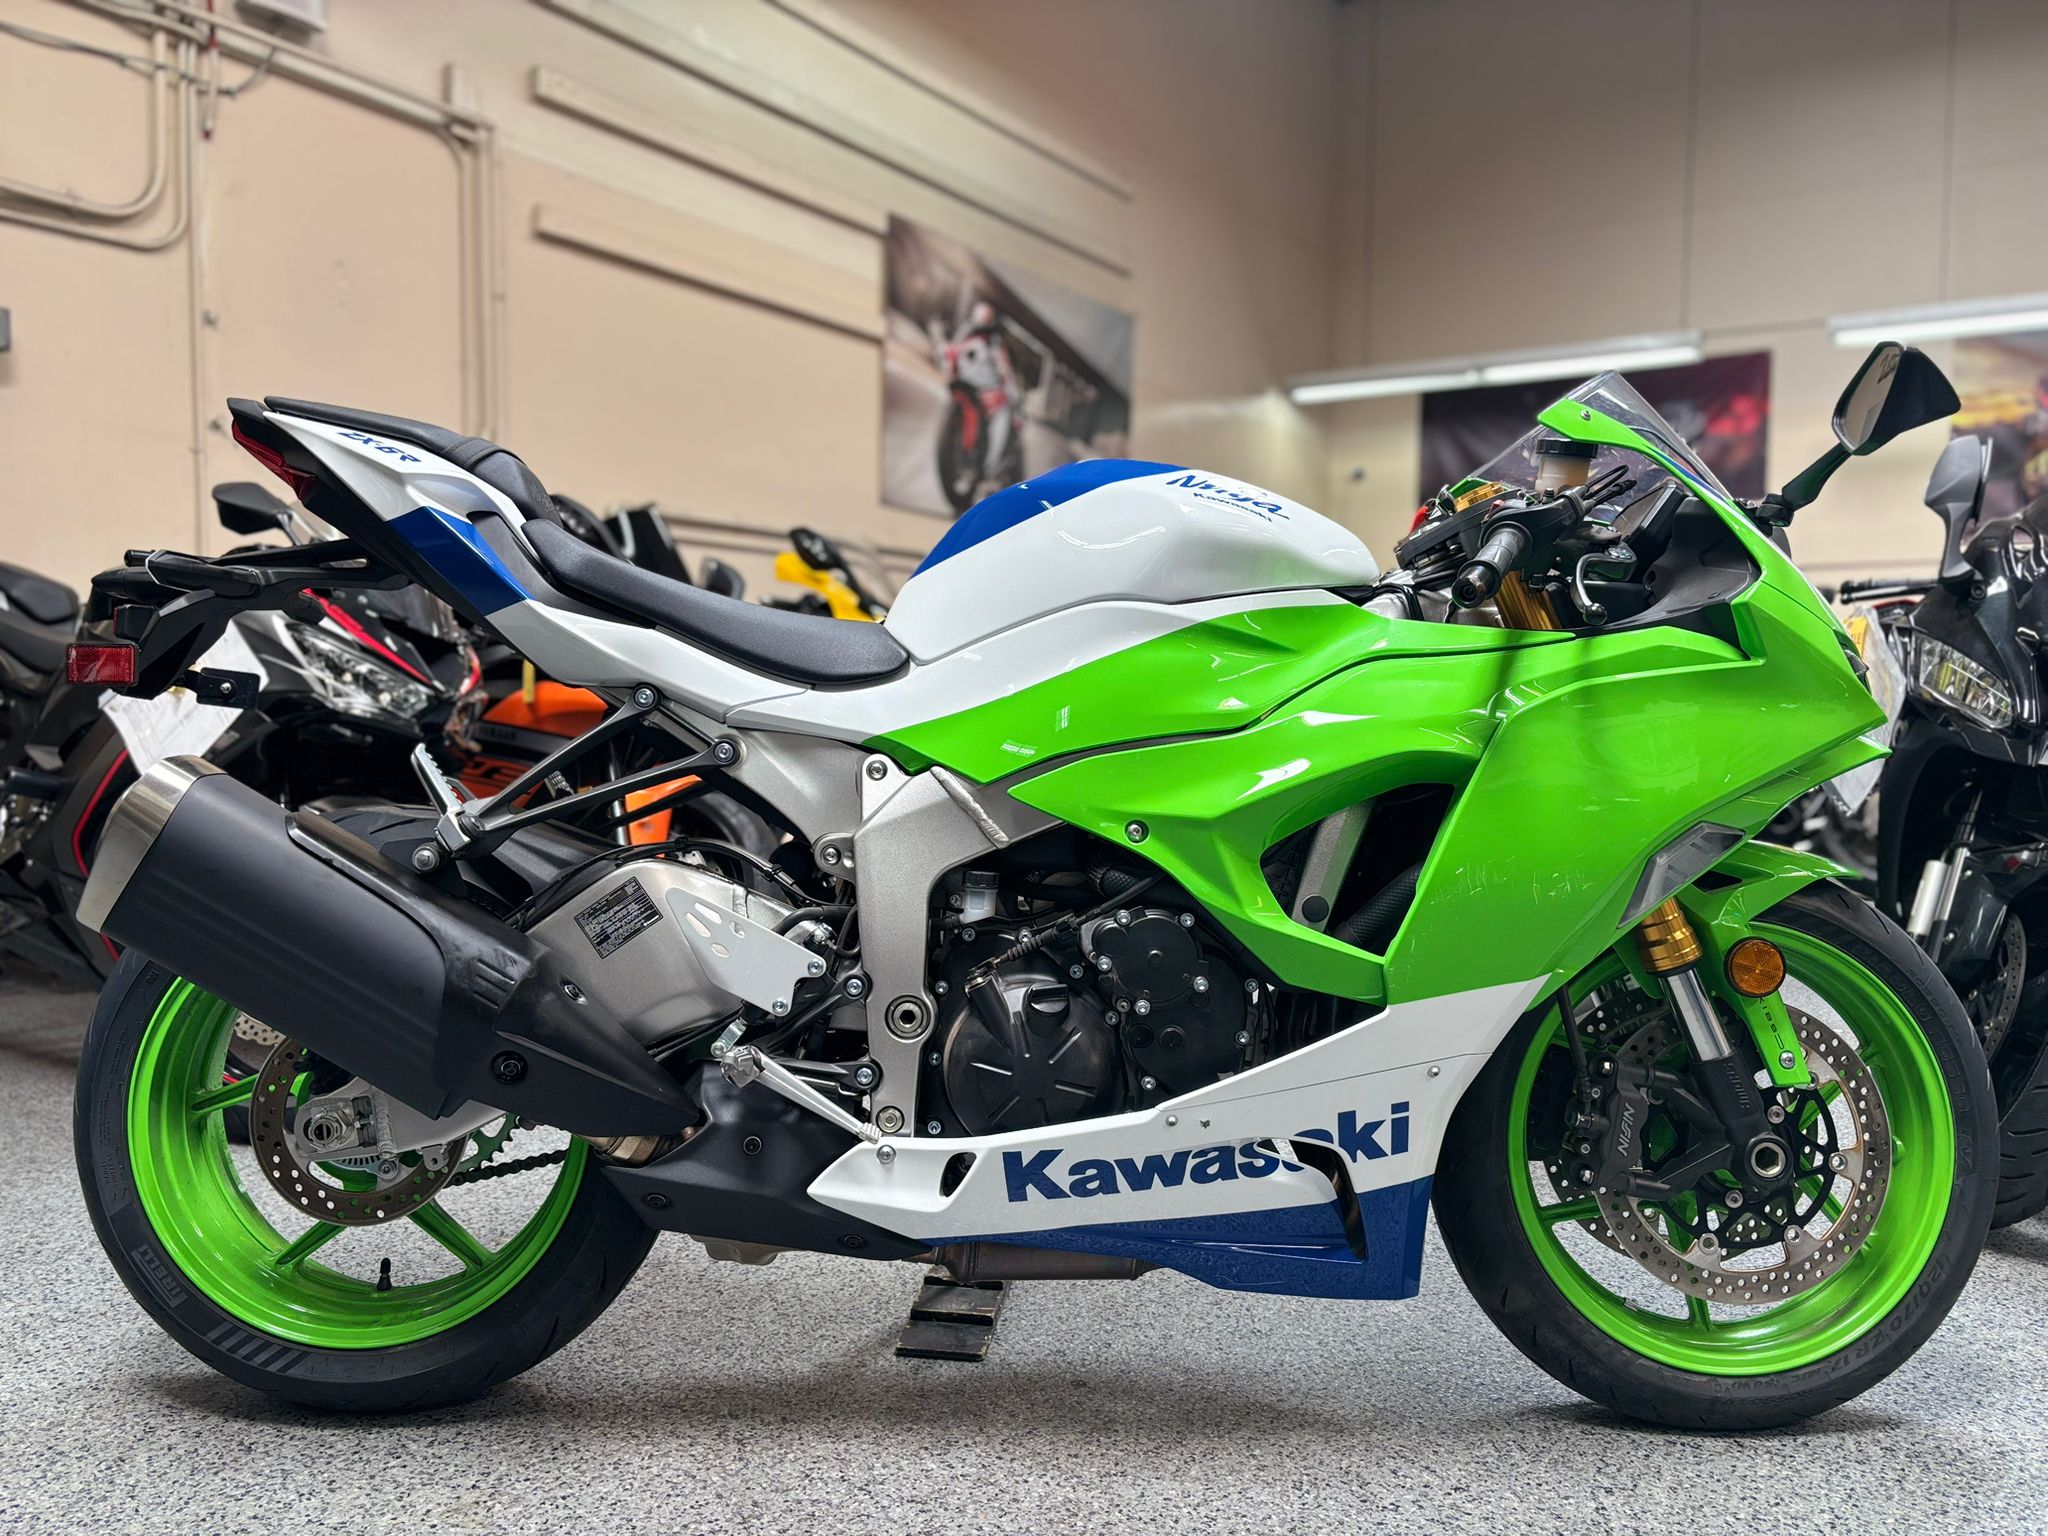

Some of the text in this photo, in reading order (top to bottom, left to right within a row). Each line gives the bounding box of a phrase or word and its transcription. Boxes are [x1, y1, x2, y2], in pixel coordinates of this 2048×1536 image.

[1166, 475, 1290, 519] Ninja
[1617, 1102, 1635, 1157] NISSIN
[131, 1244, 189, 1308] PIRELLI
